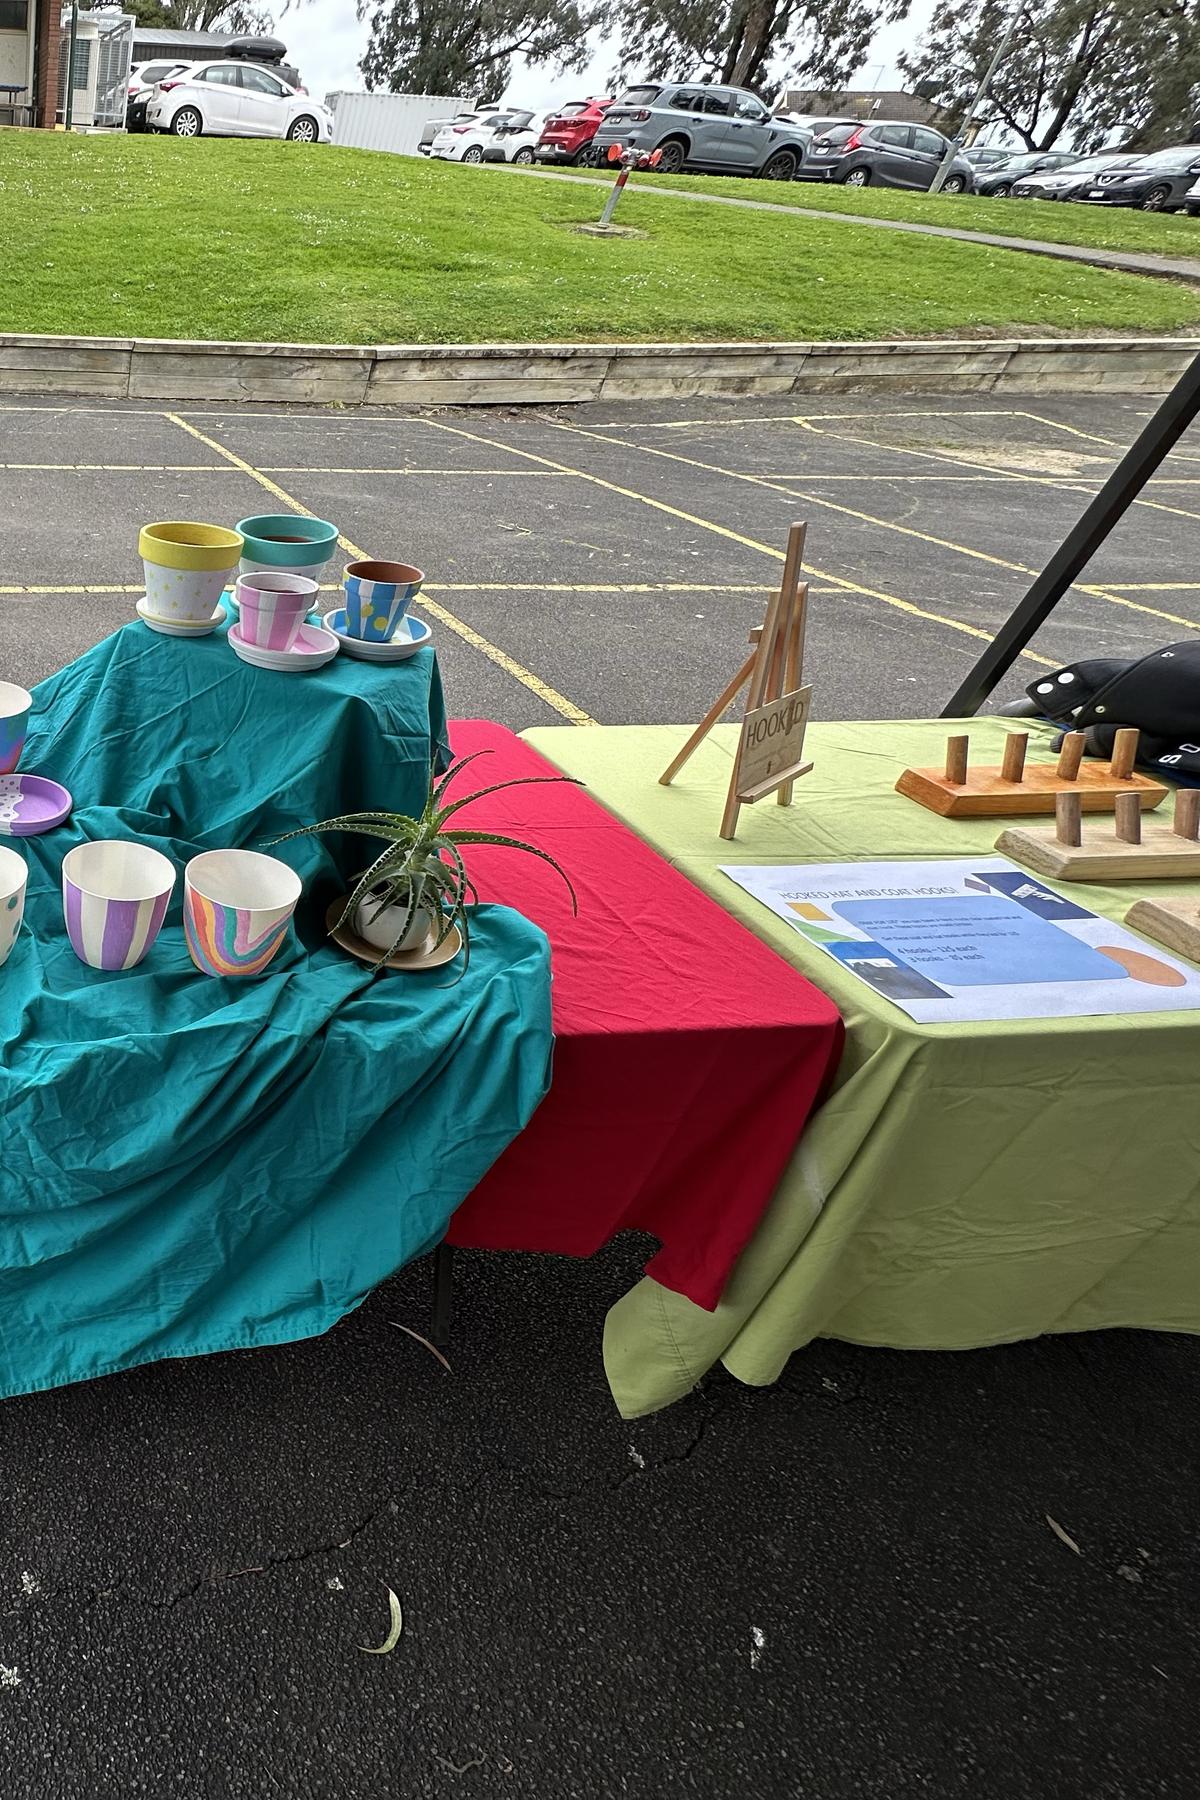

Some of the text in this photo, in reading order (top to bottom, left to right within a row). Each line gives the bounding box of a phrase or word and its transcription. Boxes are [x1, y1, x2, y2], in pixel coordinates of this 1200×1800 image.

[779, 890, 830, 900] HOOKED
[829, 889, 853, 898] HAT
[855, 889, 882, 897] AND
[881, 888, 911, 896] COAT
[955, 944, 978, 952] each
